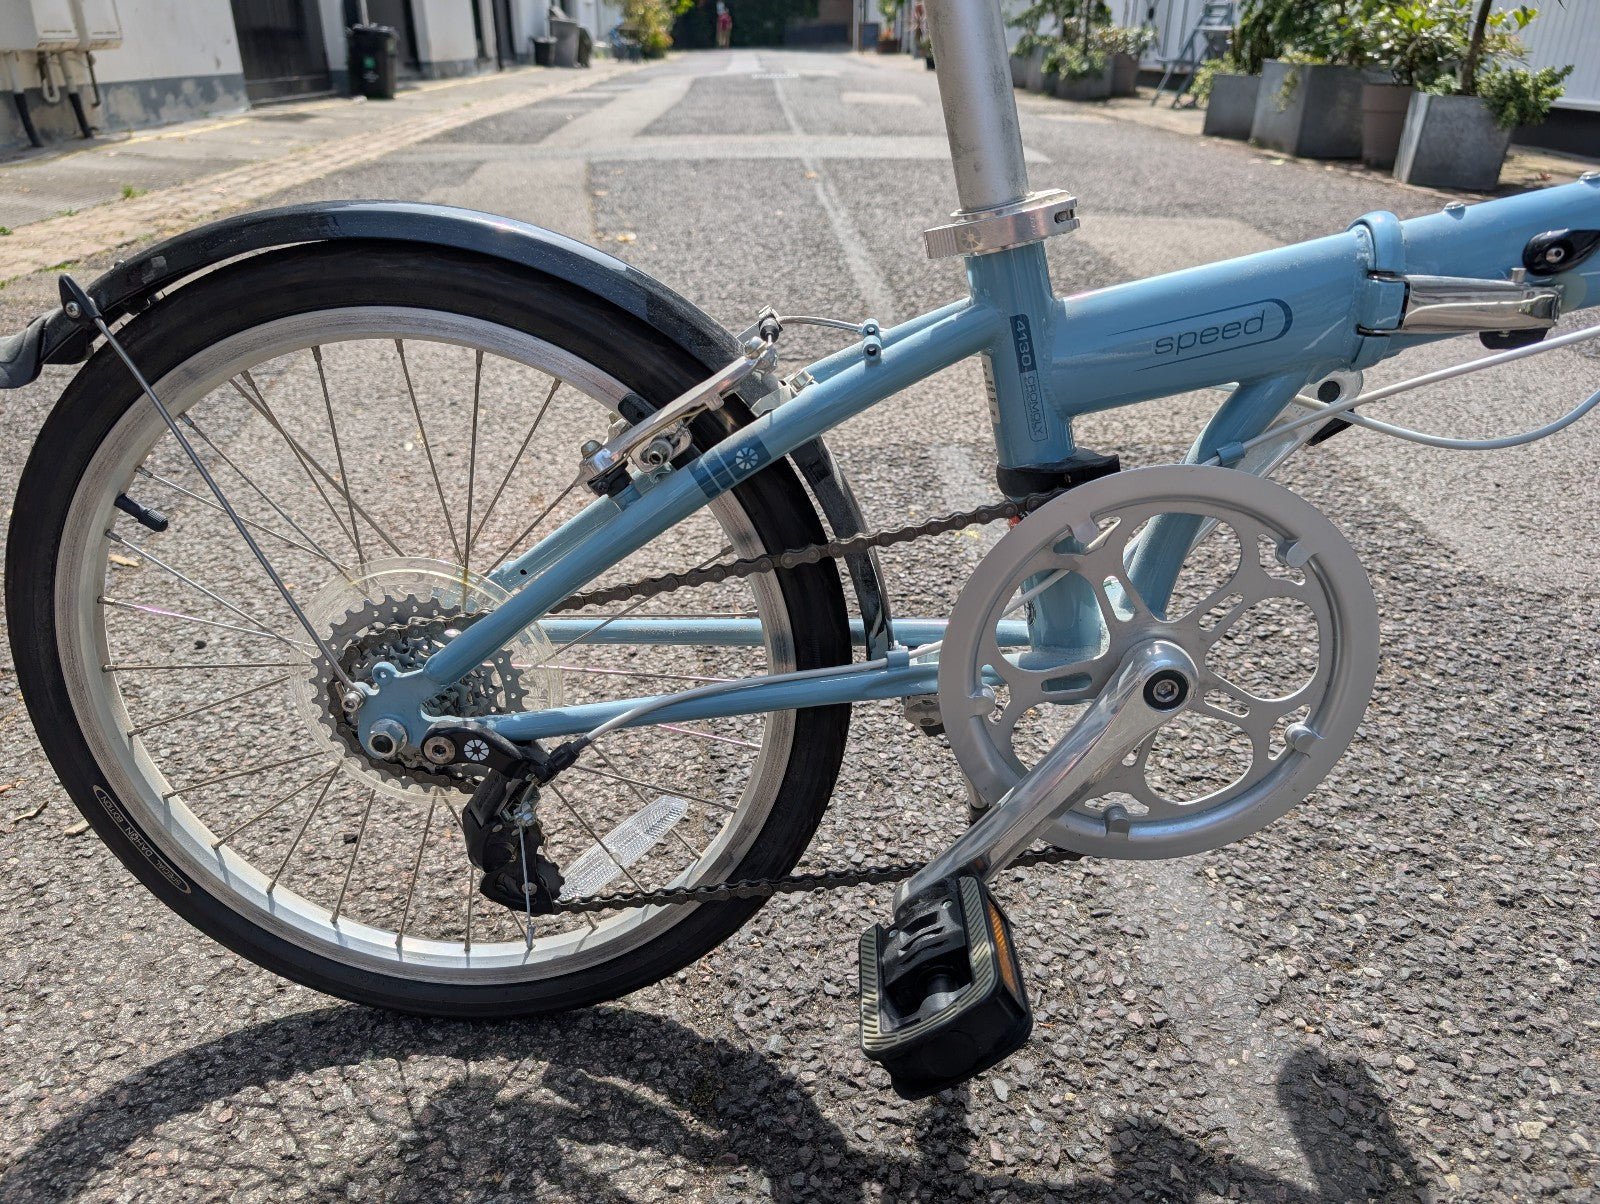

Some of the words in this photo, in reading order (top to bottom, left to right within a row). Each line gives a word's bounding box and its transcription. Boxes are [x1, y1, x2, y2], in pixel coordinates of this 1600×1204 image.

[1015, 320, 1032, 367] 4130
[1154, 309, 1266, 355] speed
[1027, 375, 1043, 434] CROMOLY
[100, 796, 124, 823] EDITION
[125, 827, 153, 857] DAHON
[156, 859, 181, 886] SPECIAL
